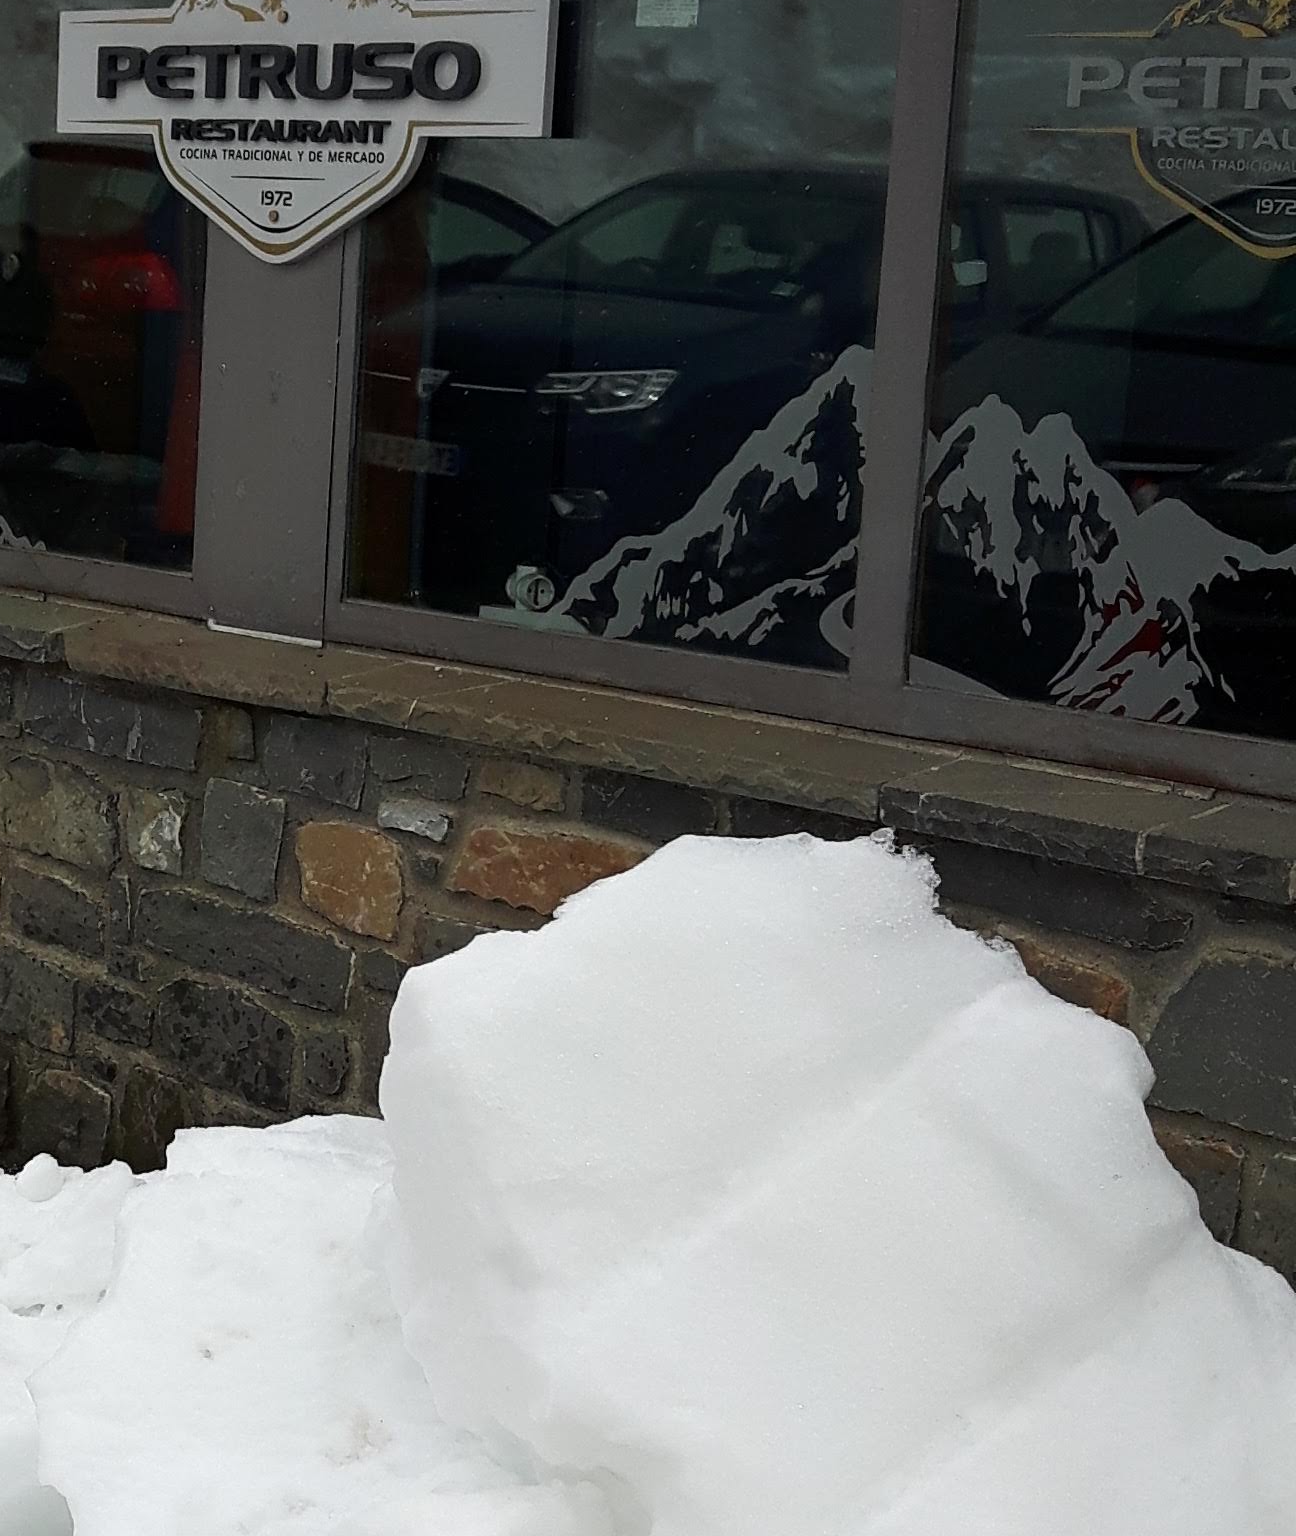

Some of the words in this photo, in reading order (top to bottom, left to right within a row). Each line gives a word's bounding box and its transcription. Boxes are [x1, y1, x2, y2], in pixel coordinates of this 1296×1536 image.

[96, 41, 482, 102] PETRUSO
[171, 118, 392, 145] RESTAURANT
[179, 148, 217, 161] COCINA
[222, 148, 293, 163] TRADICIONAL
[297, 150, 304, 163] Y
[308, 150, 324, 163] DE
[328, 151, 386, 164] MERCADO
[1157, 157, 1205, 170] COCINA
[260, 190, 294, 207] 1972
